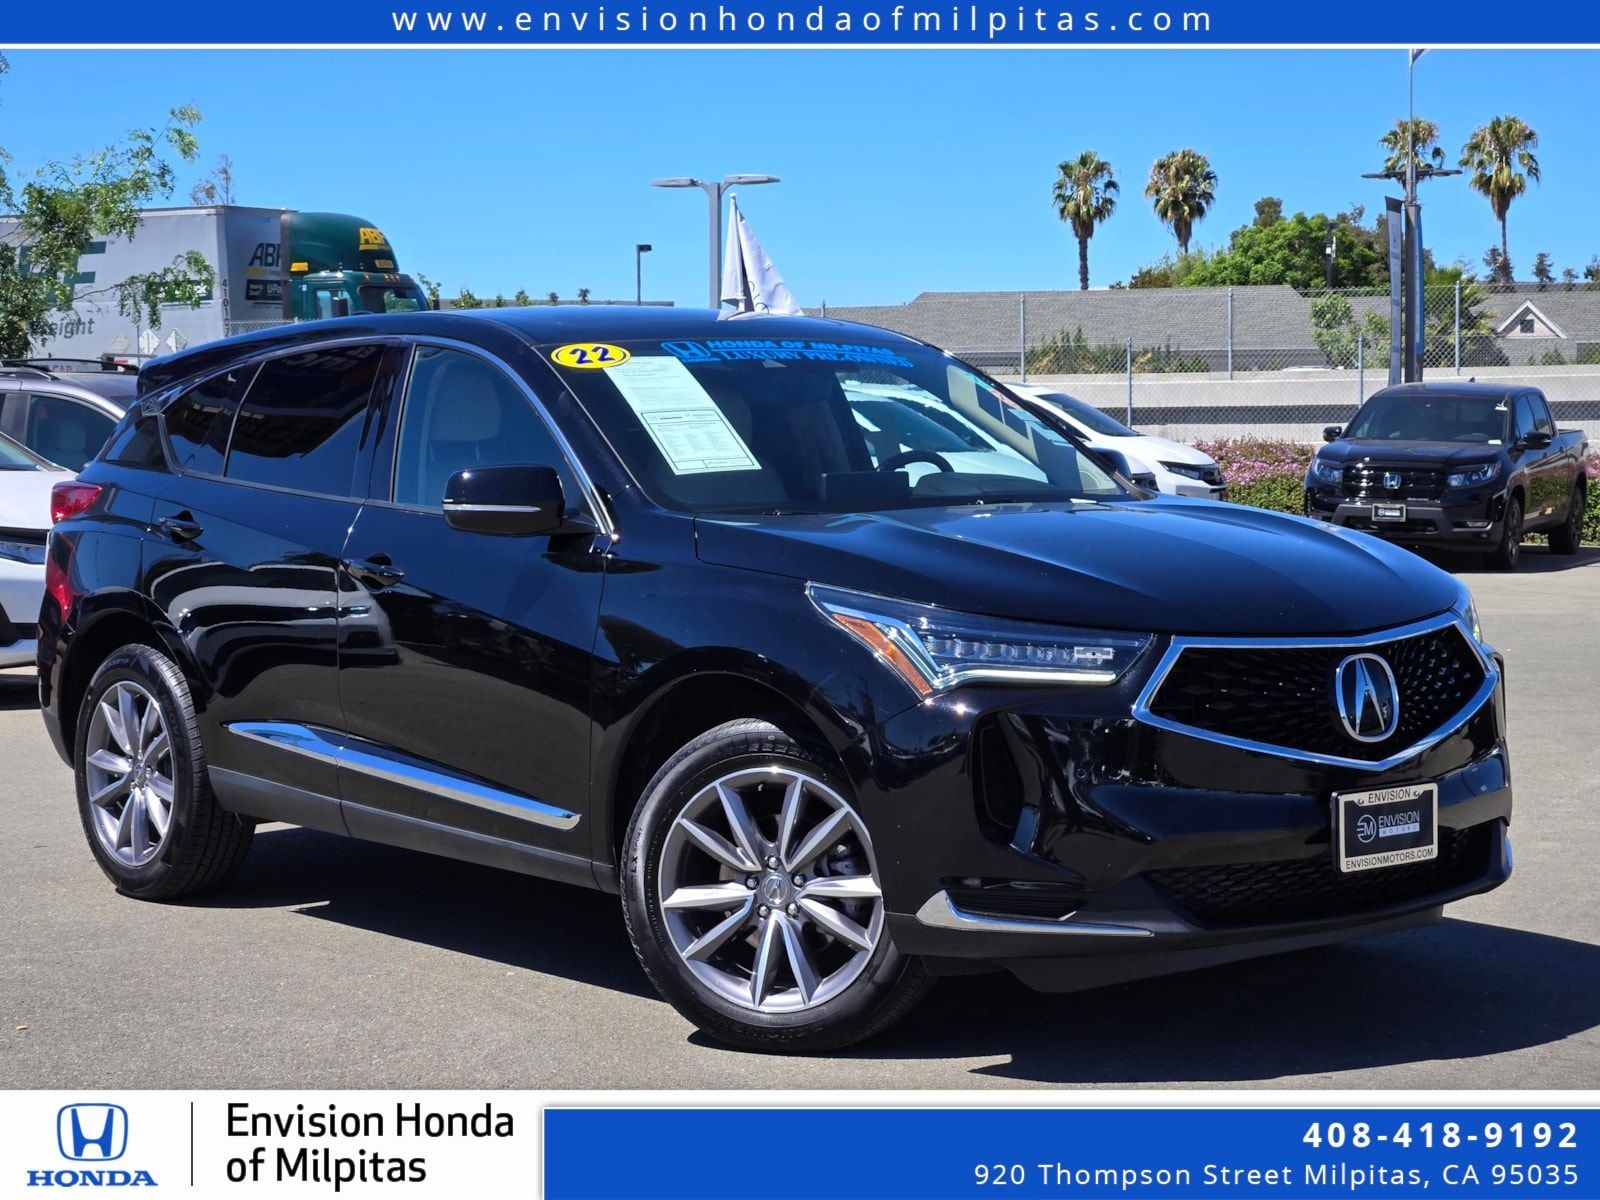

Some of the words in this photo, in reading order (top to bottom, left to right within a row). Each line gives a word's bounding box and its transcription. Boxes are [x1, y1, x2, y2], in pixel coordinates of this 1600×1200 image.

[569, 346, 616, 365] 22
[706, 340, 778, 349] HONDA
[780, 341, 806, 350] OF
[810, 342, 896, 356] MILPITAS
[719, 351, 802, 360] LUXURY
[1368, 788, 1411, 804] ENVISION
[1378, 810, 1421, 828] ENVISION
[1345, 847, 1434, 870] ENVISIONMOTORS.COM
